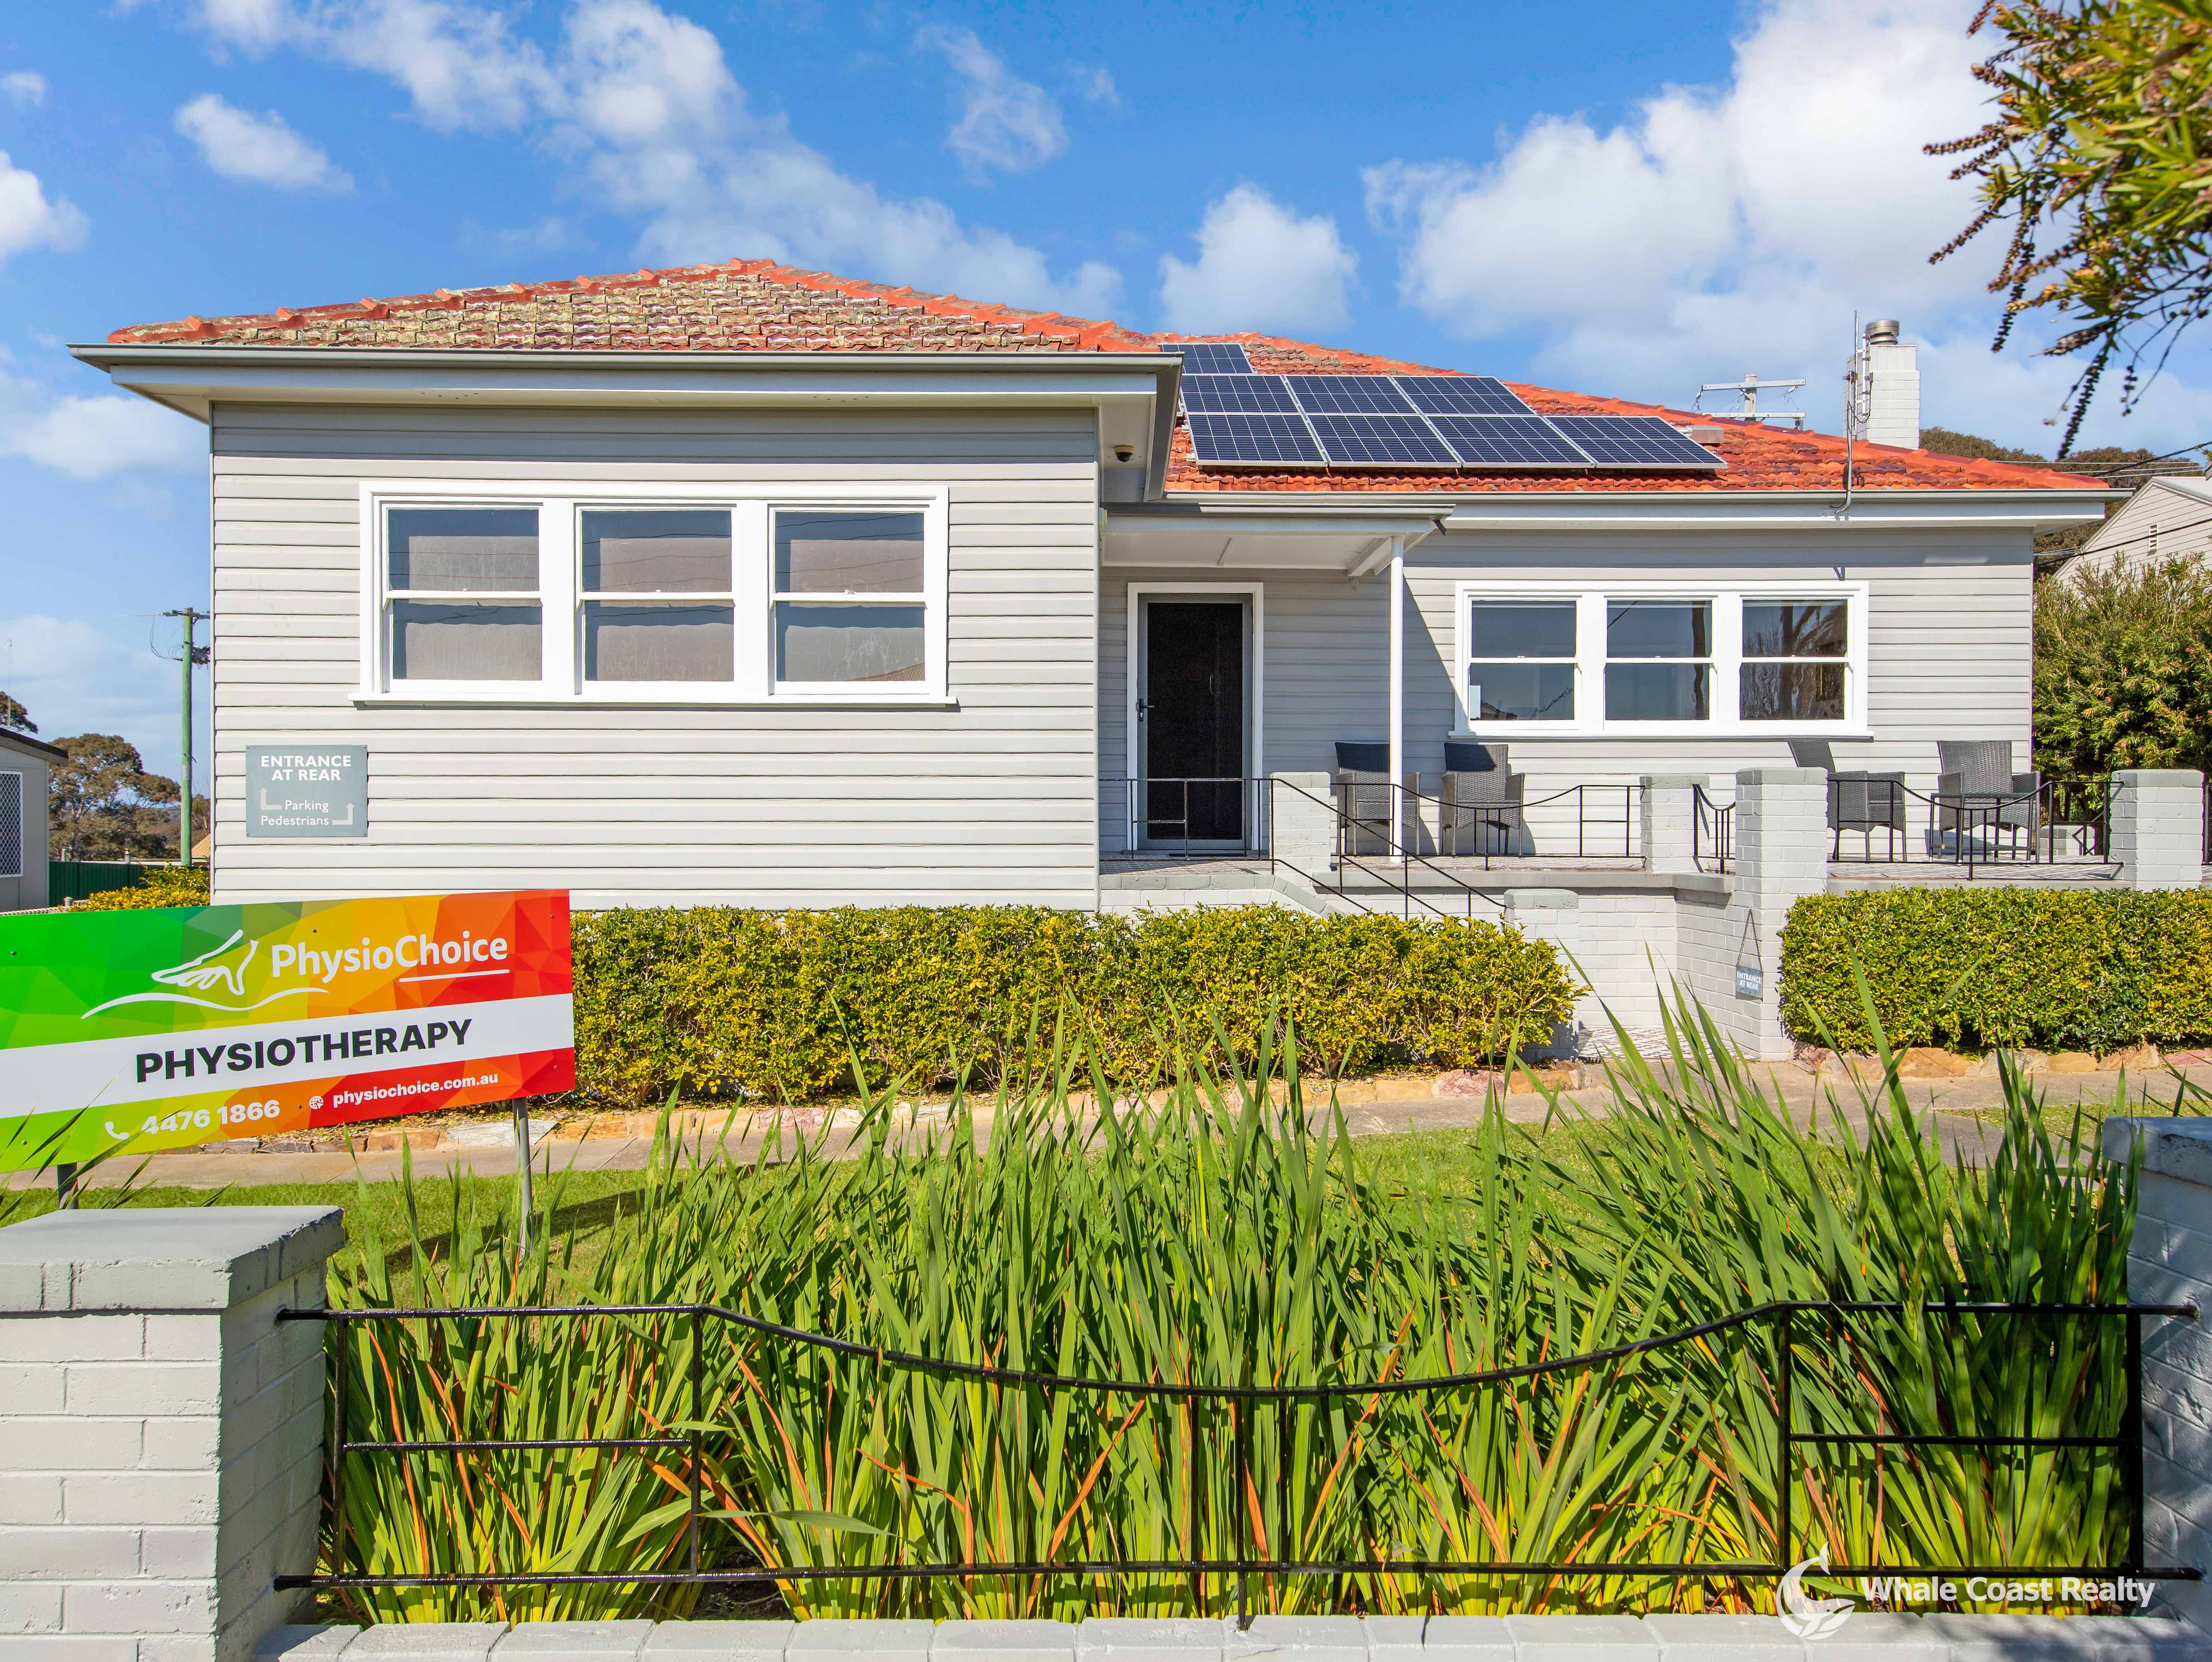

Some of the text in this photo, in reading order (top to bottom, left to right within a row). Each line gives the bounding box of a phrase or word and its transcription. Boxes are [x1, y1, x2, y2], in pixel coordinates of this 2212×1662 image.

[261, 755, 352, 767] ENTRANCE
[271, 769, 341, 781] AT REAR
[285, 800, 329, 813] Parking
[261, 815, 329, 825] Pedestrians
[272, 930, 507, 983] PhysioChoice
[1737, 971, 1761, 983] ENTRANCE
[1747, 981, 1758, 990] REAR
[136, 1018, 472, 1083] PHYSIOTHERAPY
[333, 1074, 498, 1107] physiochoice.com.au
[141, 1100, 280, 1134] 4476 1866
